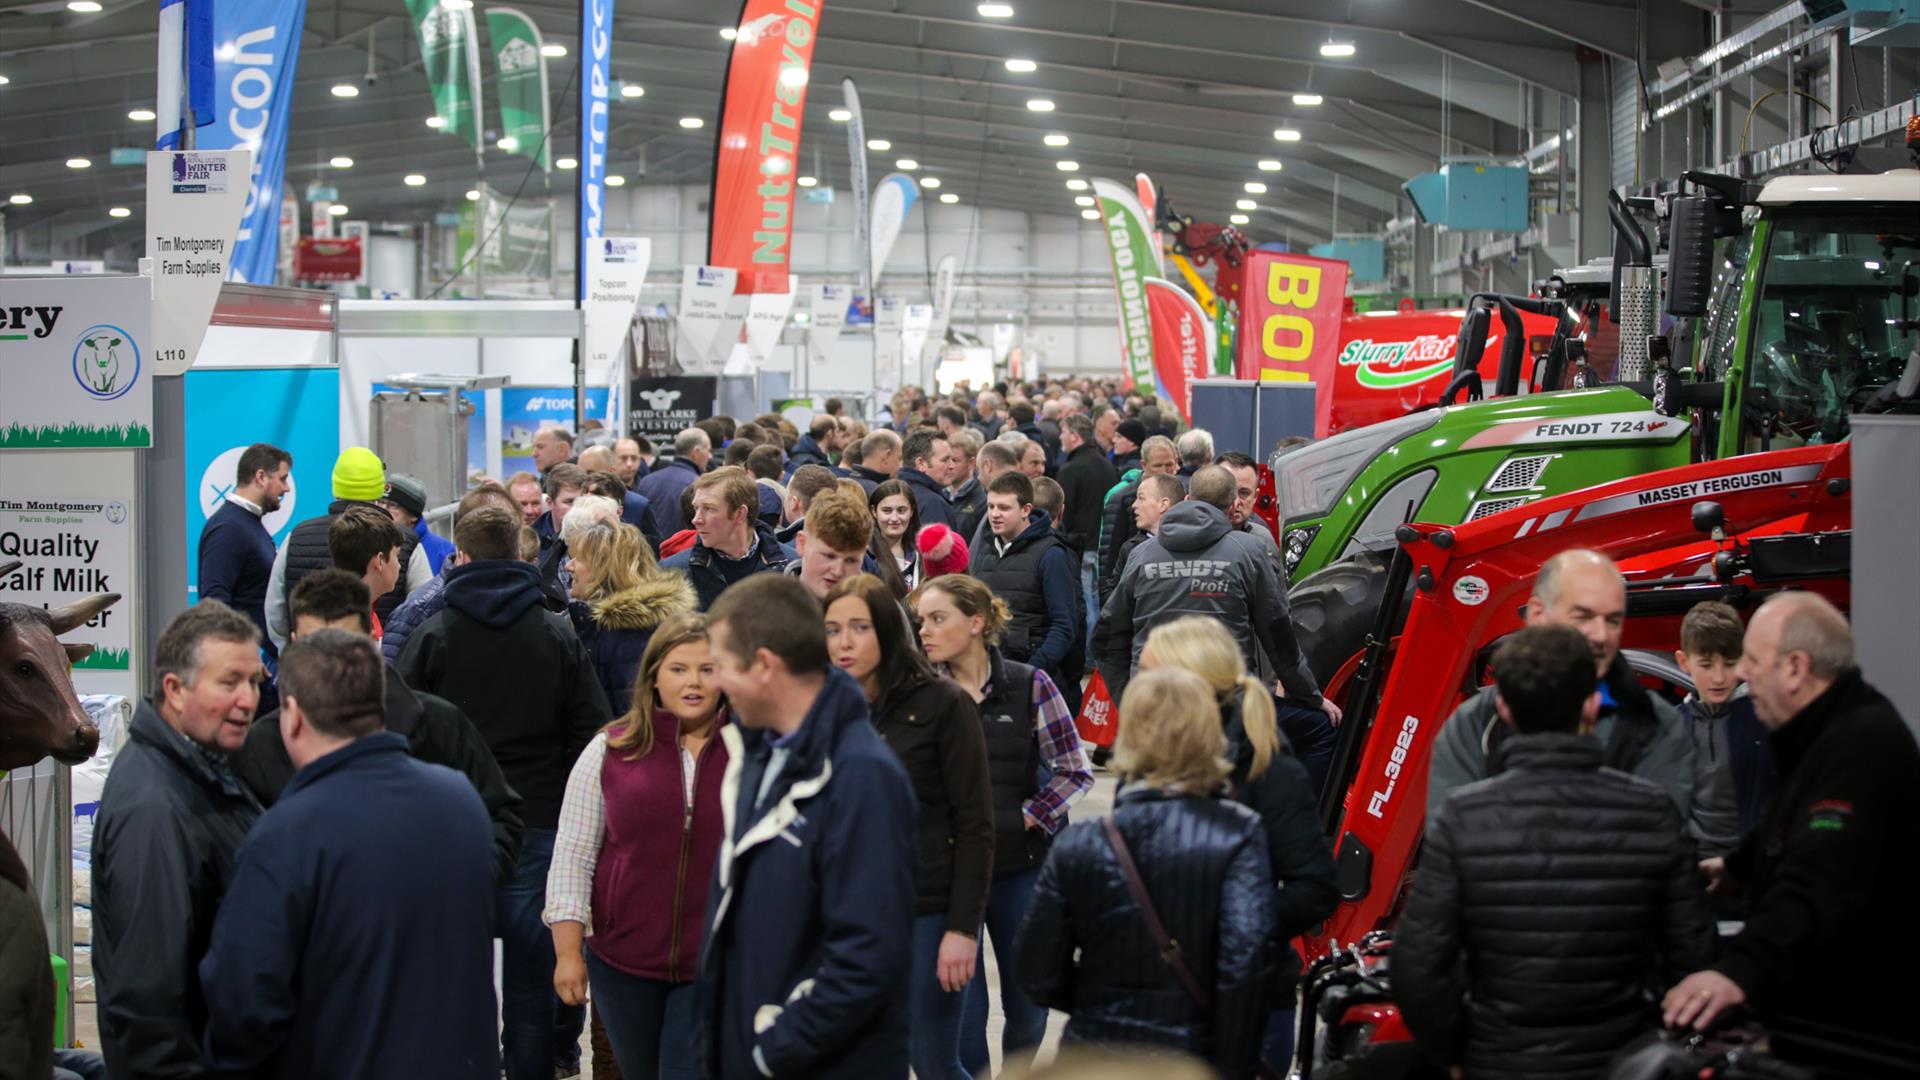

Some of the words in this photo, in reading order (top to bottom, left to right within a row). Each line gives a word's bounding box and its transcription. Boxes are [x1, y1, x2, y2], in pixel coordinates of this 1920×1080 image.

[187, 163, 227, 172] WINTER
[187, 171, 210, 180] FAIR
[156, 236, 172, 252] Tim
[174, 236, 224, 255] Montgomery
[162, 259, 184, 275] Farm
[185, 259, 221, 278] Supplies
[599, 279, 627, 290] Topcon
[592, 292, 636, 305] Positioning
[1260, 262, 1322, 382] BO
[1338, 333, 1458, 369] SlurryKat
[545, 398, 595, 411] TOPCN
[629, 409, 655, 419] AVID
[655, 409, 697, 418] CLARKE
[631, 419, 697, 430] IVESTOCK
[1535, 422, 1602, 437] FENDT
[1610, 420, 1645, 434] 724
[1637, 483, 1698, 506] MASSEY
[1703, 470, 1782, 495] FERGUSON
[0, 501, 23, 510] Tim
[26, 501, 104, 513] Montgomery
[18, 515, 42, 523] Farm
[44, 515, 84, 524] Supplies
[0, 531, 100, 564] Quality
[1143, 559, 1232, 580] FENDT
[53, 567, 110, 593] Milk
[1190, 578, 1230, 593] Profi
[1366, 714, 1419, 819] FL.3823
